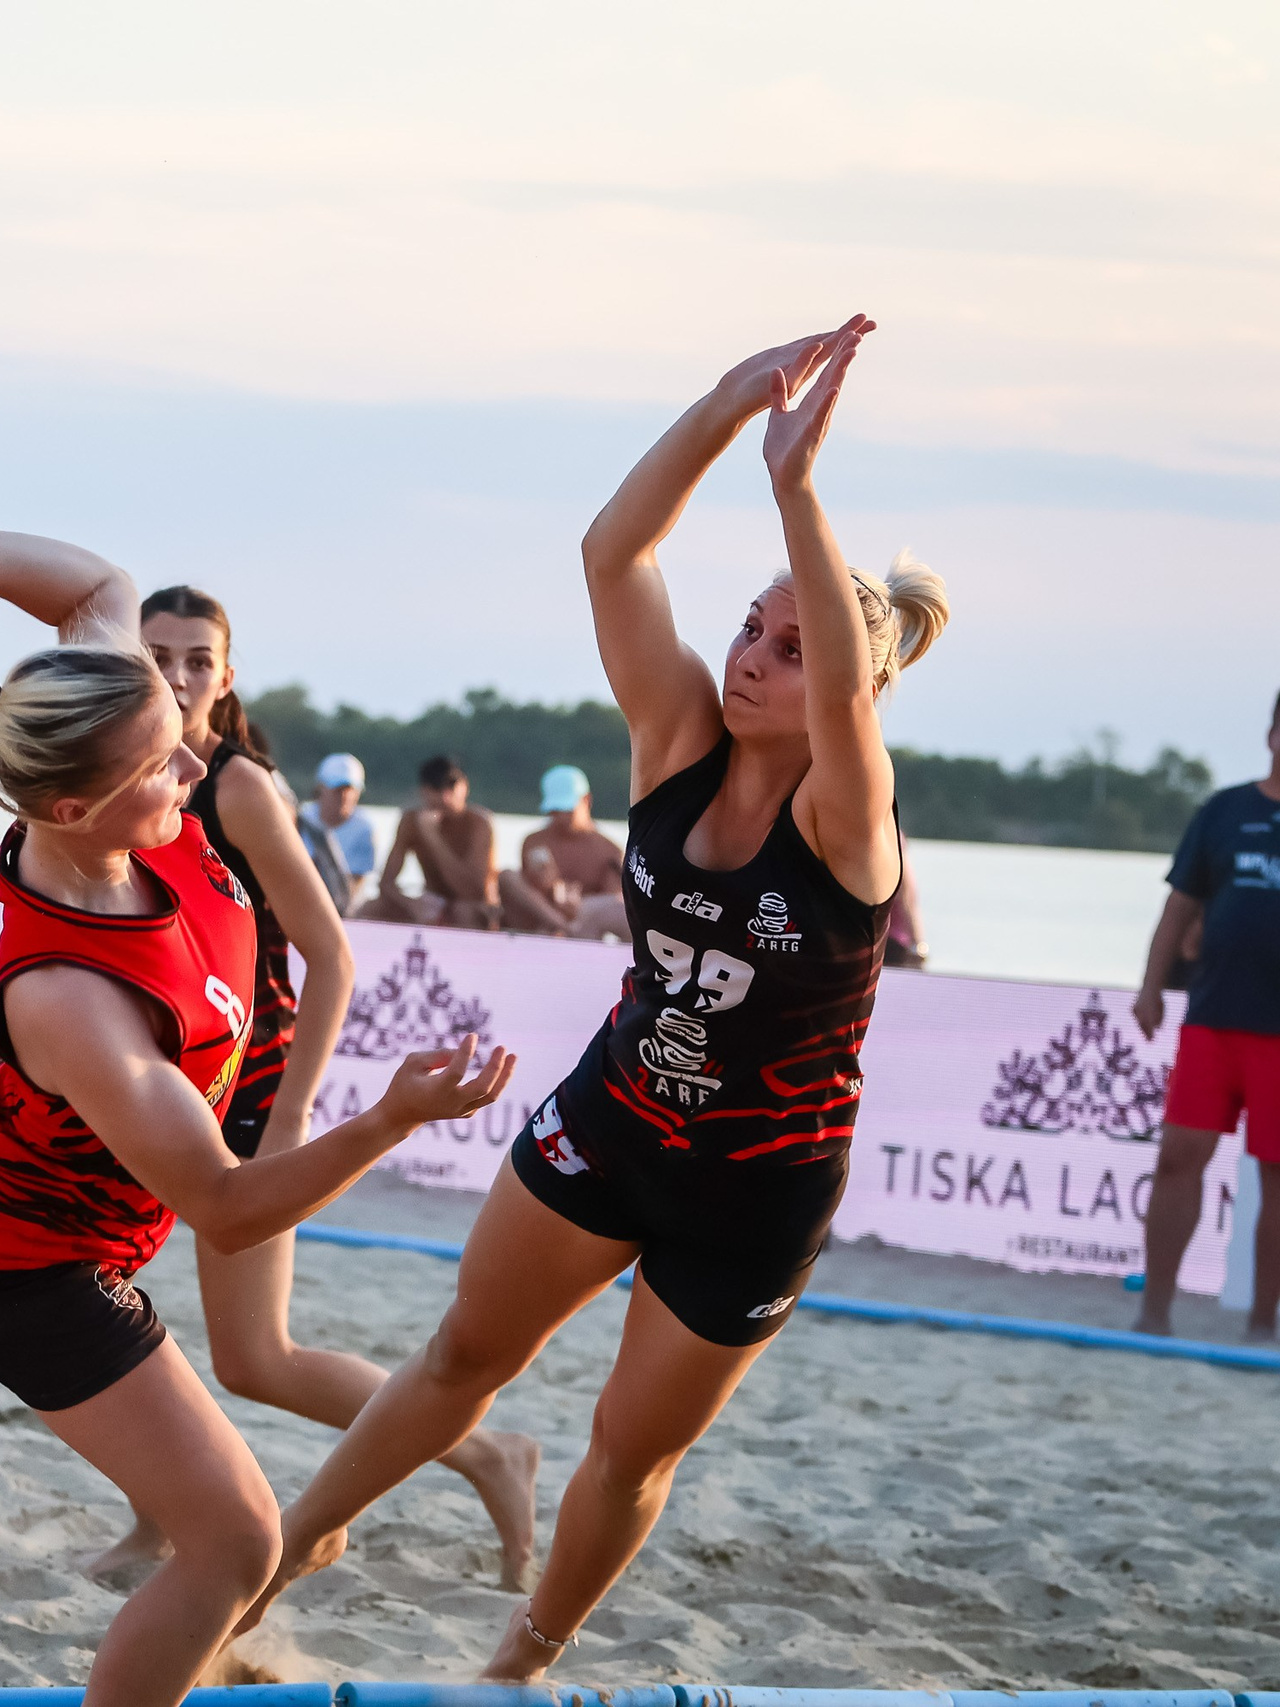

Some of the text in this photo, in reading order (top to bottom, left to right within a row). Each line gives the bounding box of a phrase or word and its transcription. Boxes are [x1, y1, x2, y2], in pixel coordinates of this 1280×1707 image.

[634, 864, 656, 898] ebt
[646, 929, 756, 1014] 99
[636, 1066, 710, 1107] 2ARE
[880, 1144, 1032, 1212] TISKA
